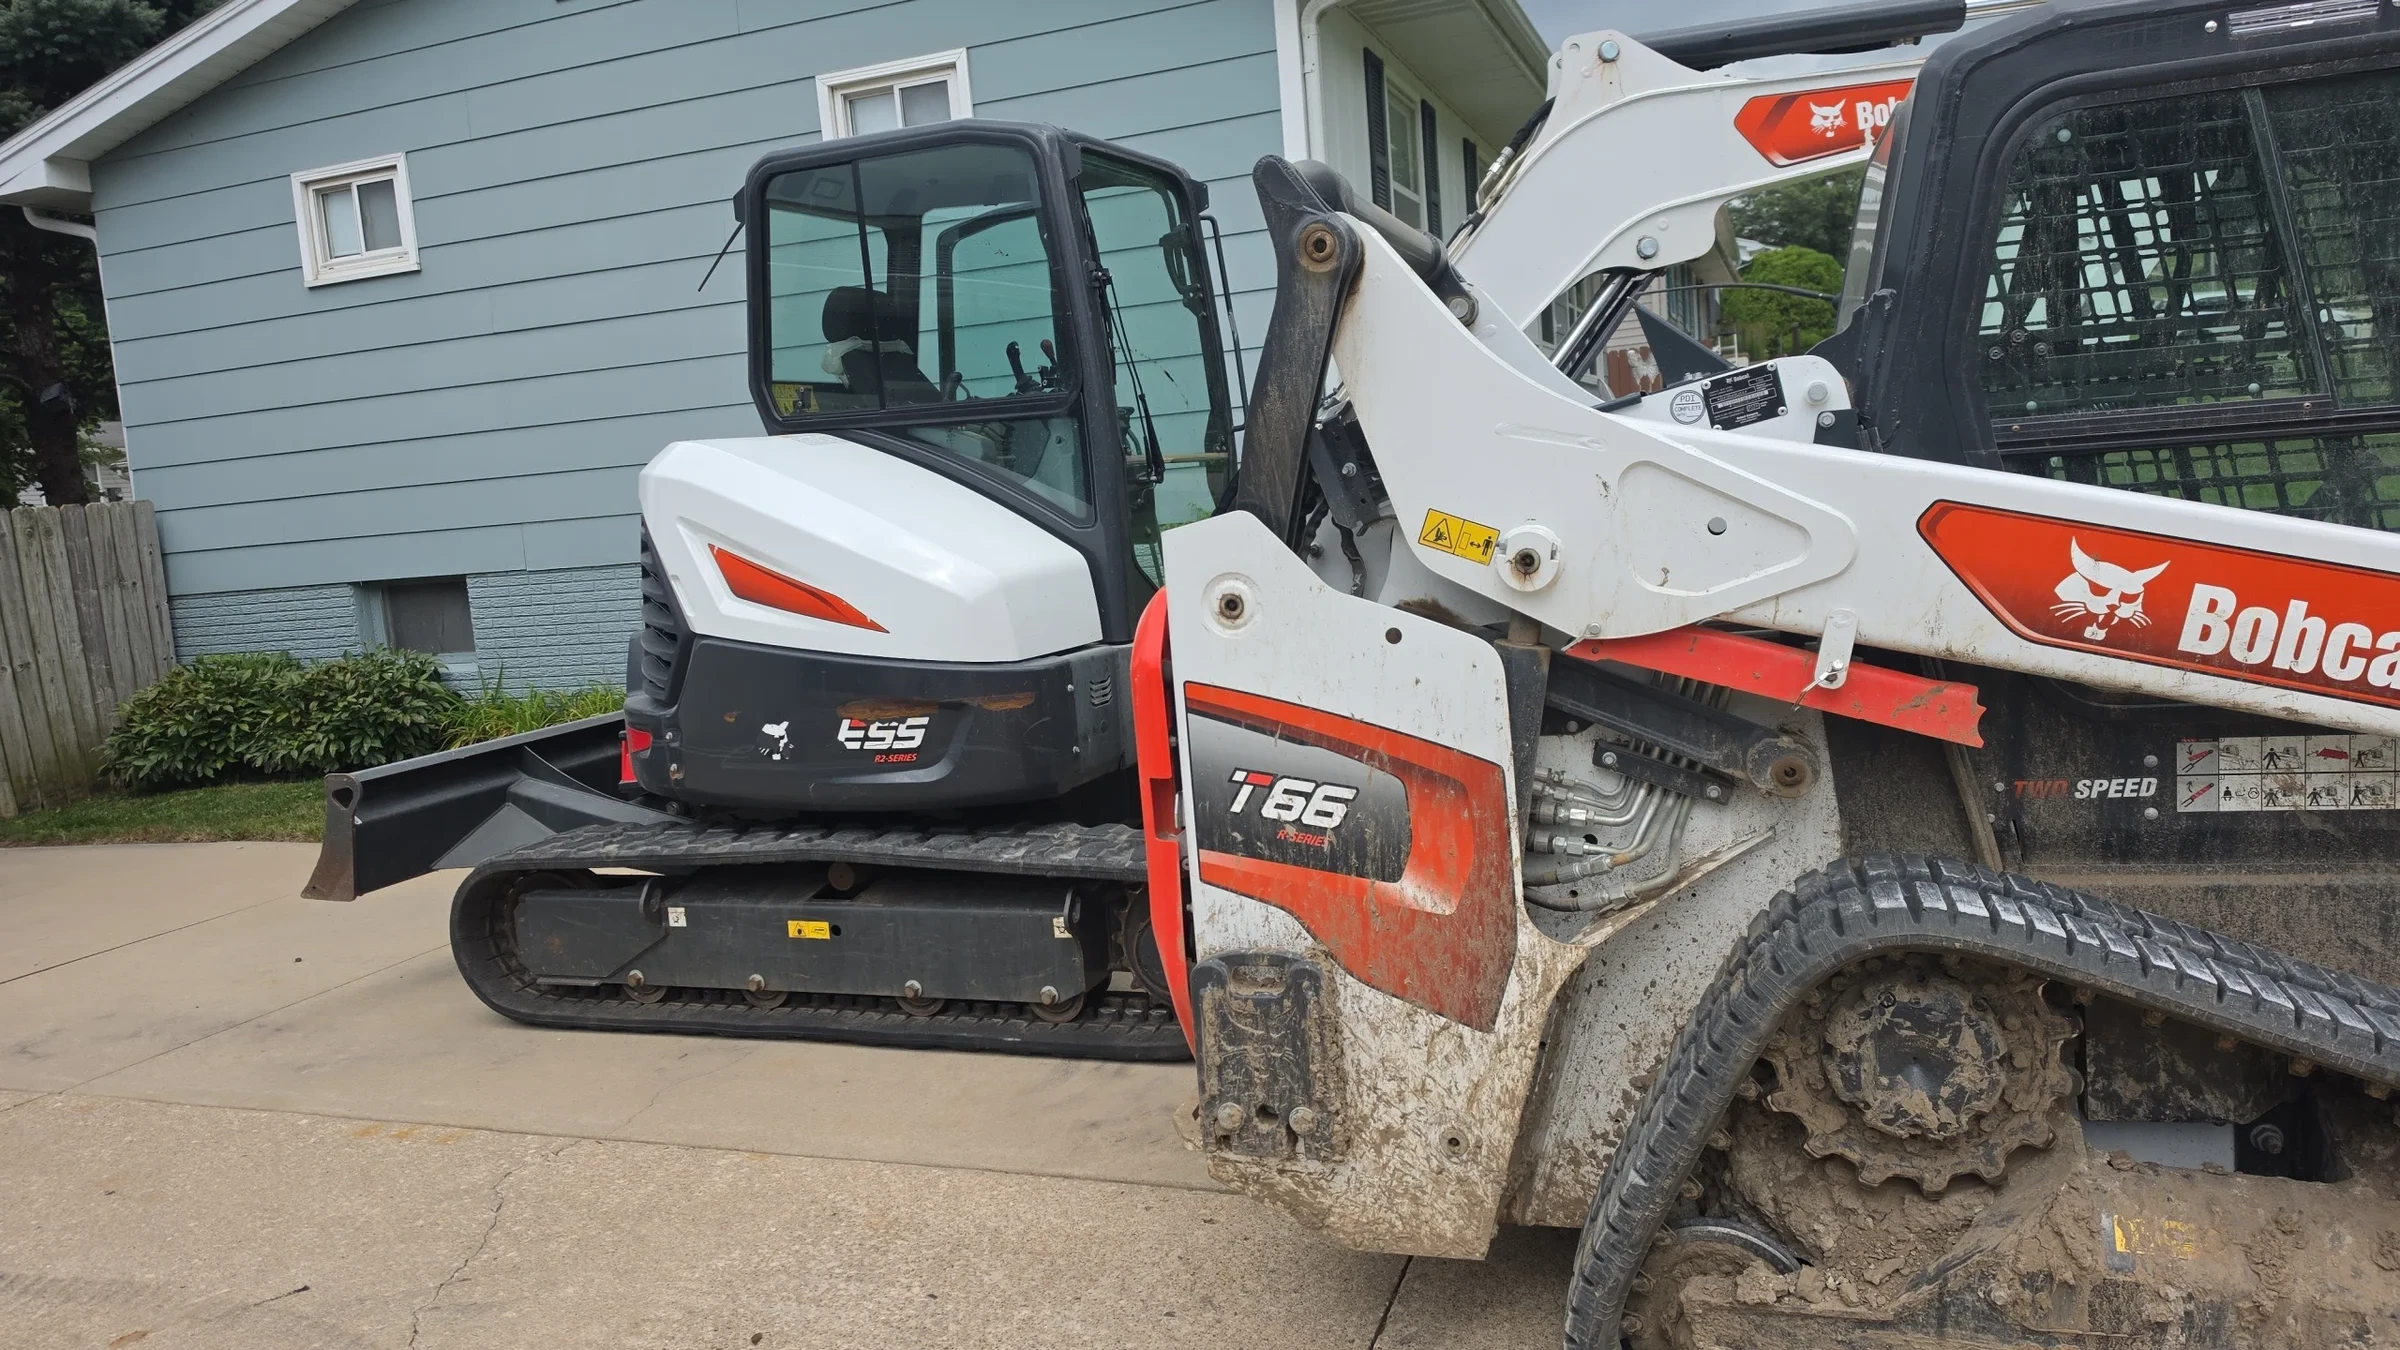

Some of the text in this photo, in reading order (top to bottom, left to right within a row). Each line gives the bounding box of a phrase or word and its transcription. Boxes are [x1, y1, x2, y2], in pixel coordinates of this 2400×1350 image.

[1680, 394, 1695, 403] PDI
[873, 753, 918, 763] R2-SERIES
[2014, 777, 2158, 799] TWO SPEED
[1229, 769, 1358, 829] T66
